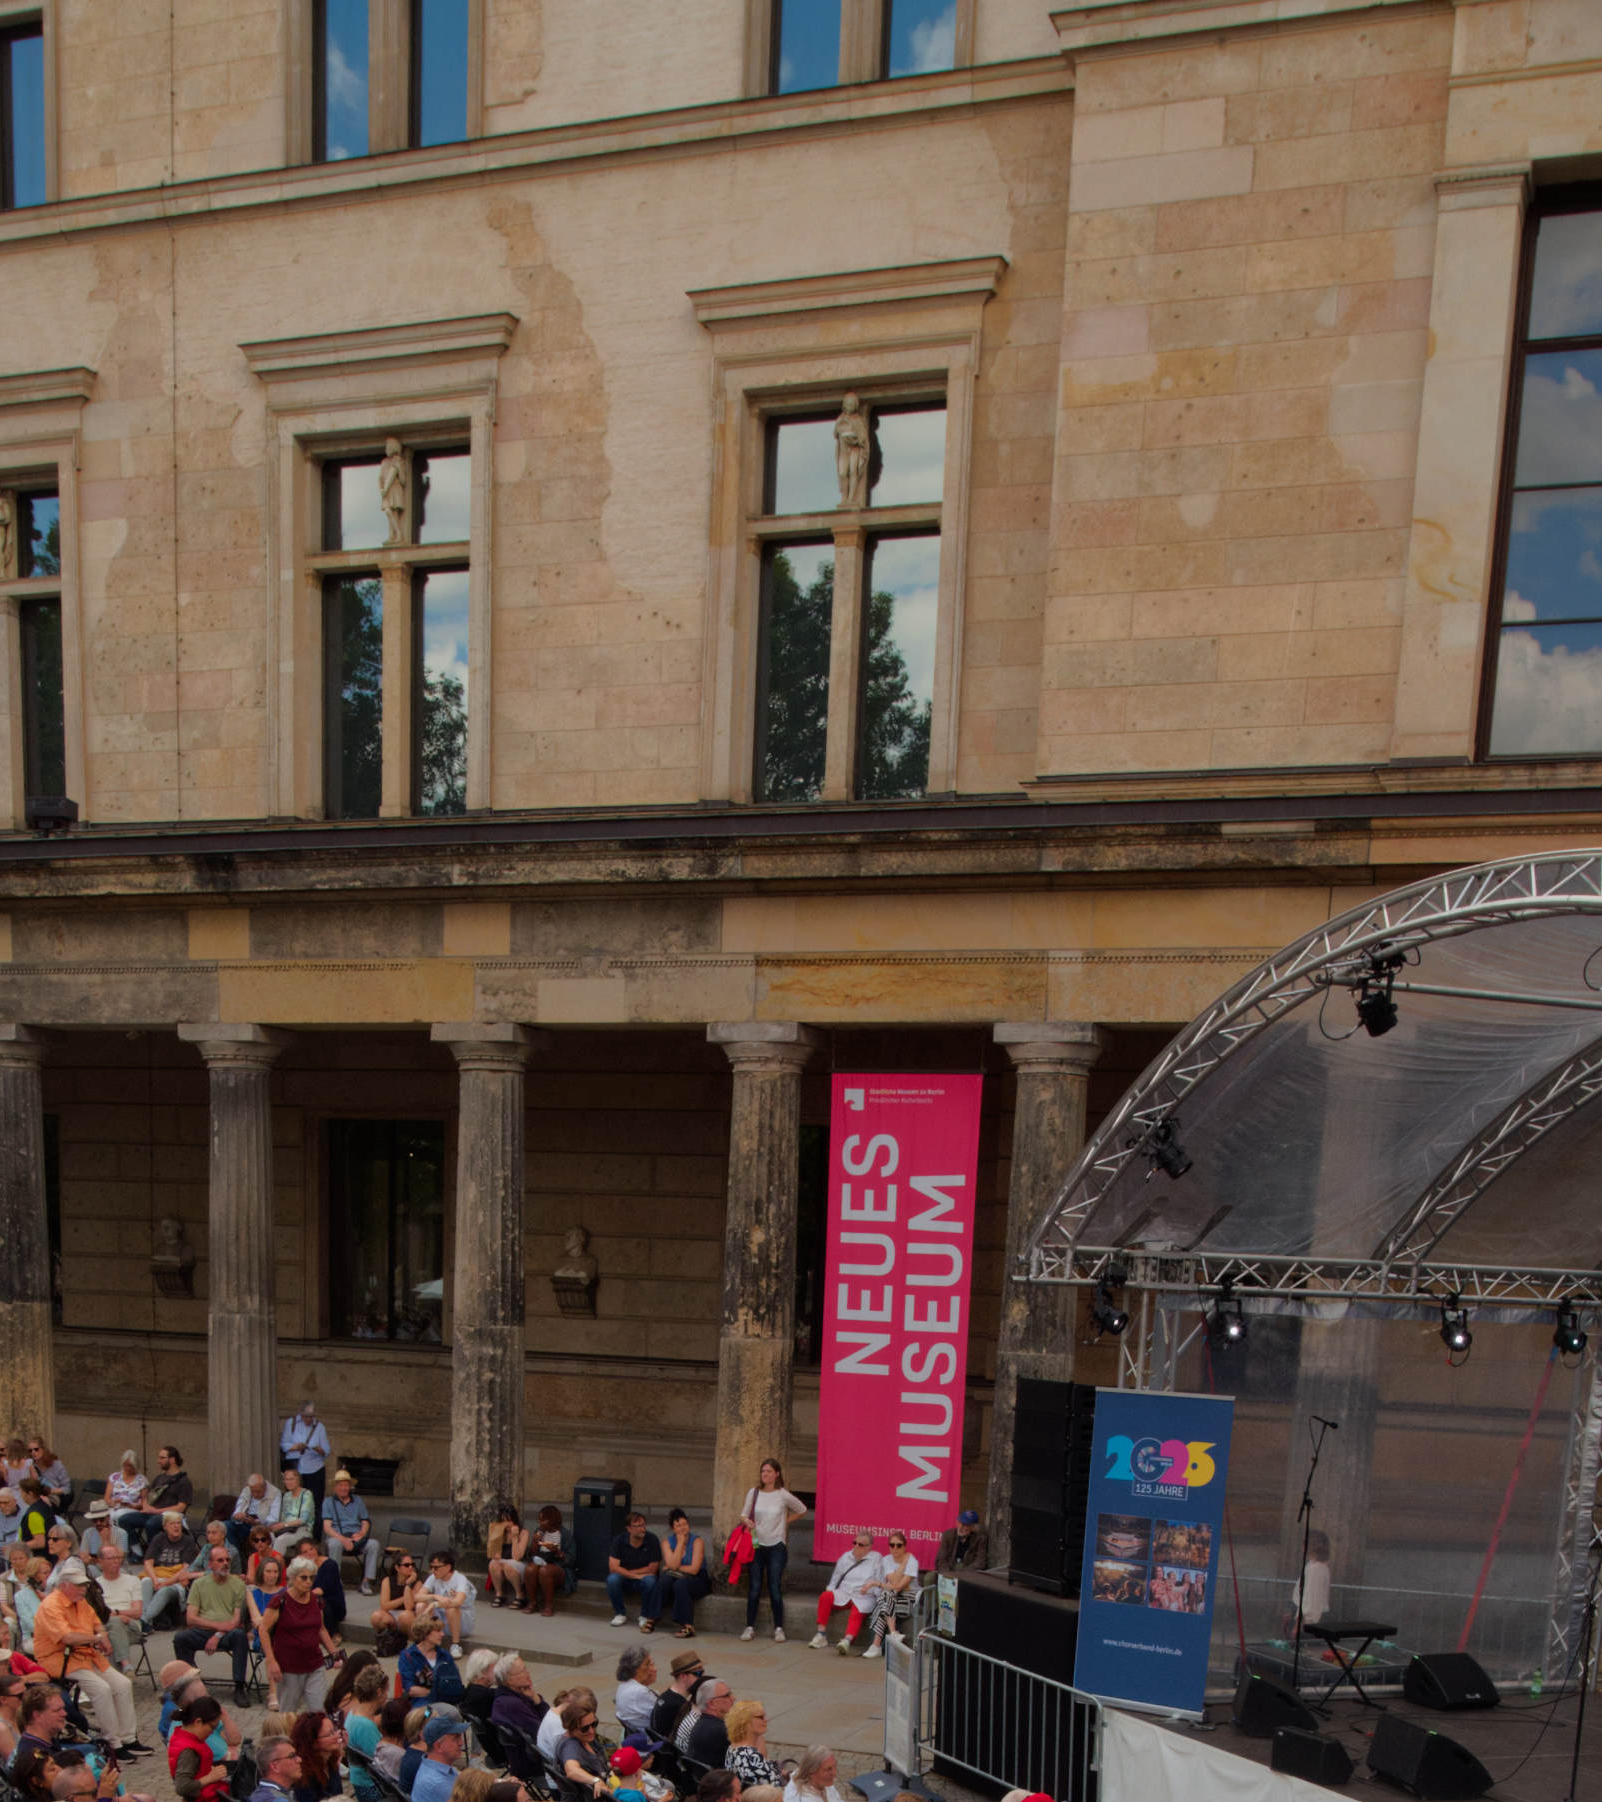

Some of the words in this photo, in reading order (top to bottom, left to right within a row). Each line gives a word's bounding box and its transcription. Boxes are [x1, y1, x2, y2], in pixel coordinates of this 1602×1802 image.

[834, 1133, 899, 1376] NEUES
[896, 1174, 966, 1503] MUSEUM
[1135, 1483, 1152, 1494] 125
[1154, 1484, 1184, 1498] JAHRE
